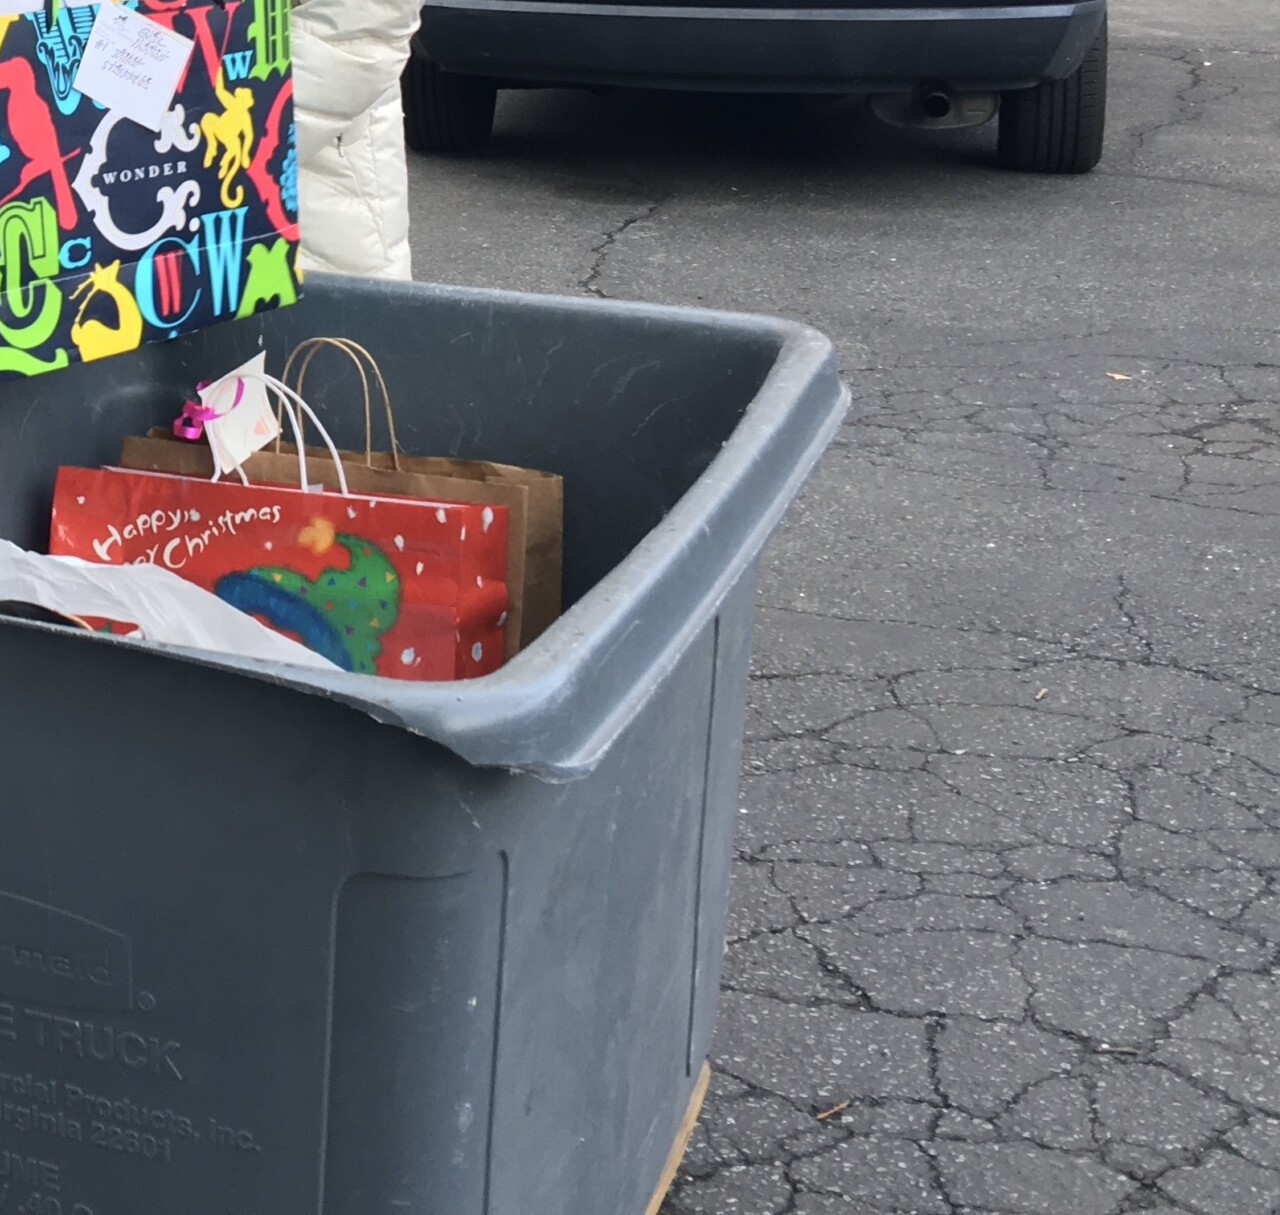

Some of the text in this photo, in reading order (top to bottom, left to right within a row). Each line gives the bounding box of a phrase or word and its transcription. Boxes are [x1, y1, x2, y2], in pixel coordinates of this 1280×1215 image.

[102, 161, 188, 185] WONDER
[58, 236, 92, 269] C
[162, 505, 282, 569] Christmas
[23, 1005, 185, 1081] TRUCK
[64, 1082, 200, 1144] Products,
